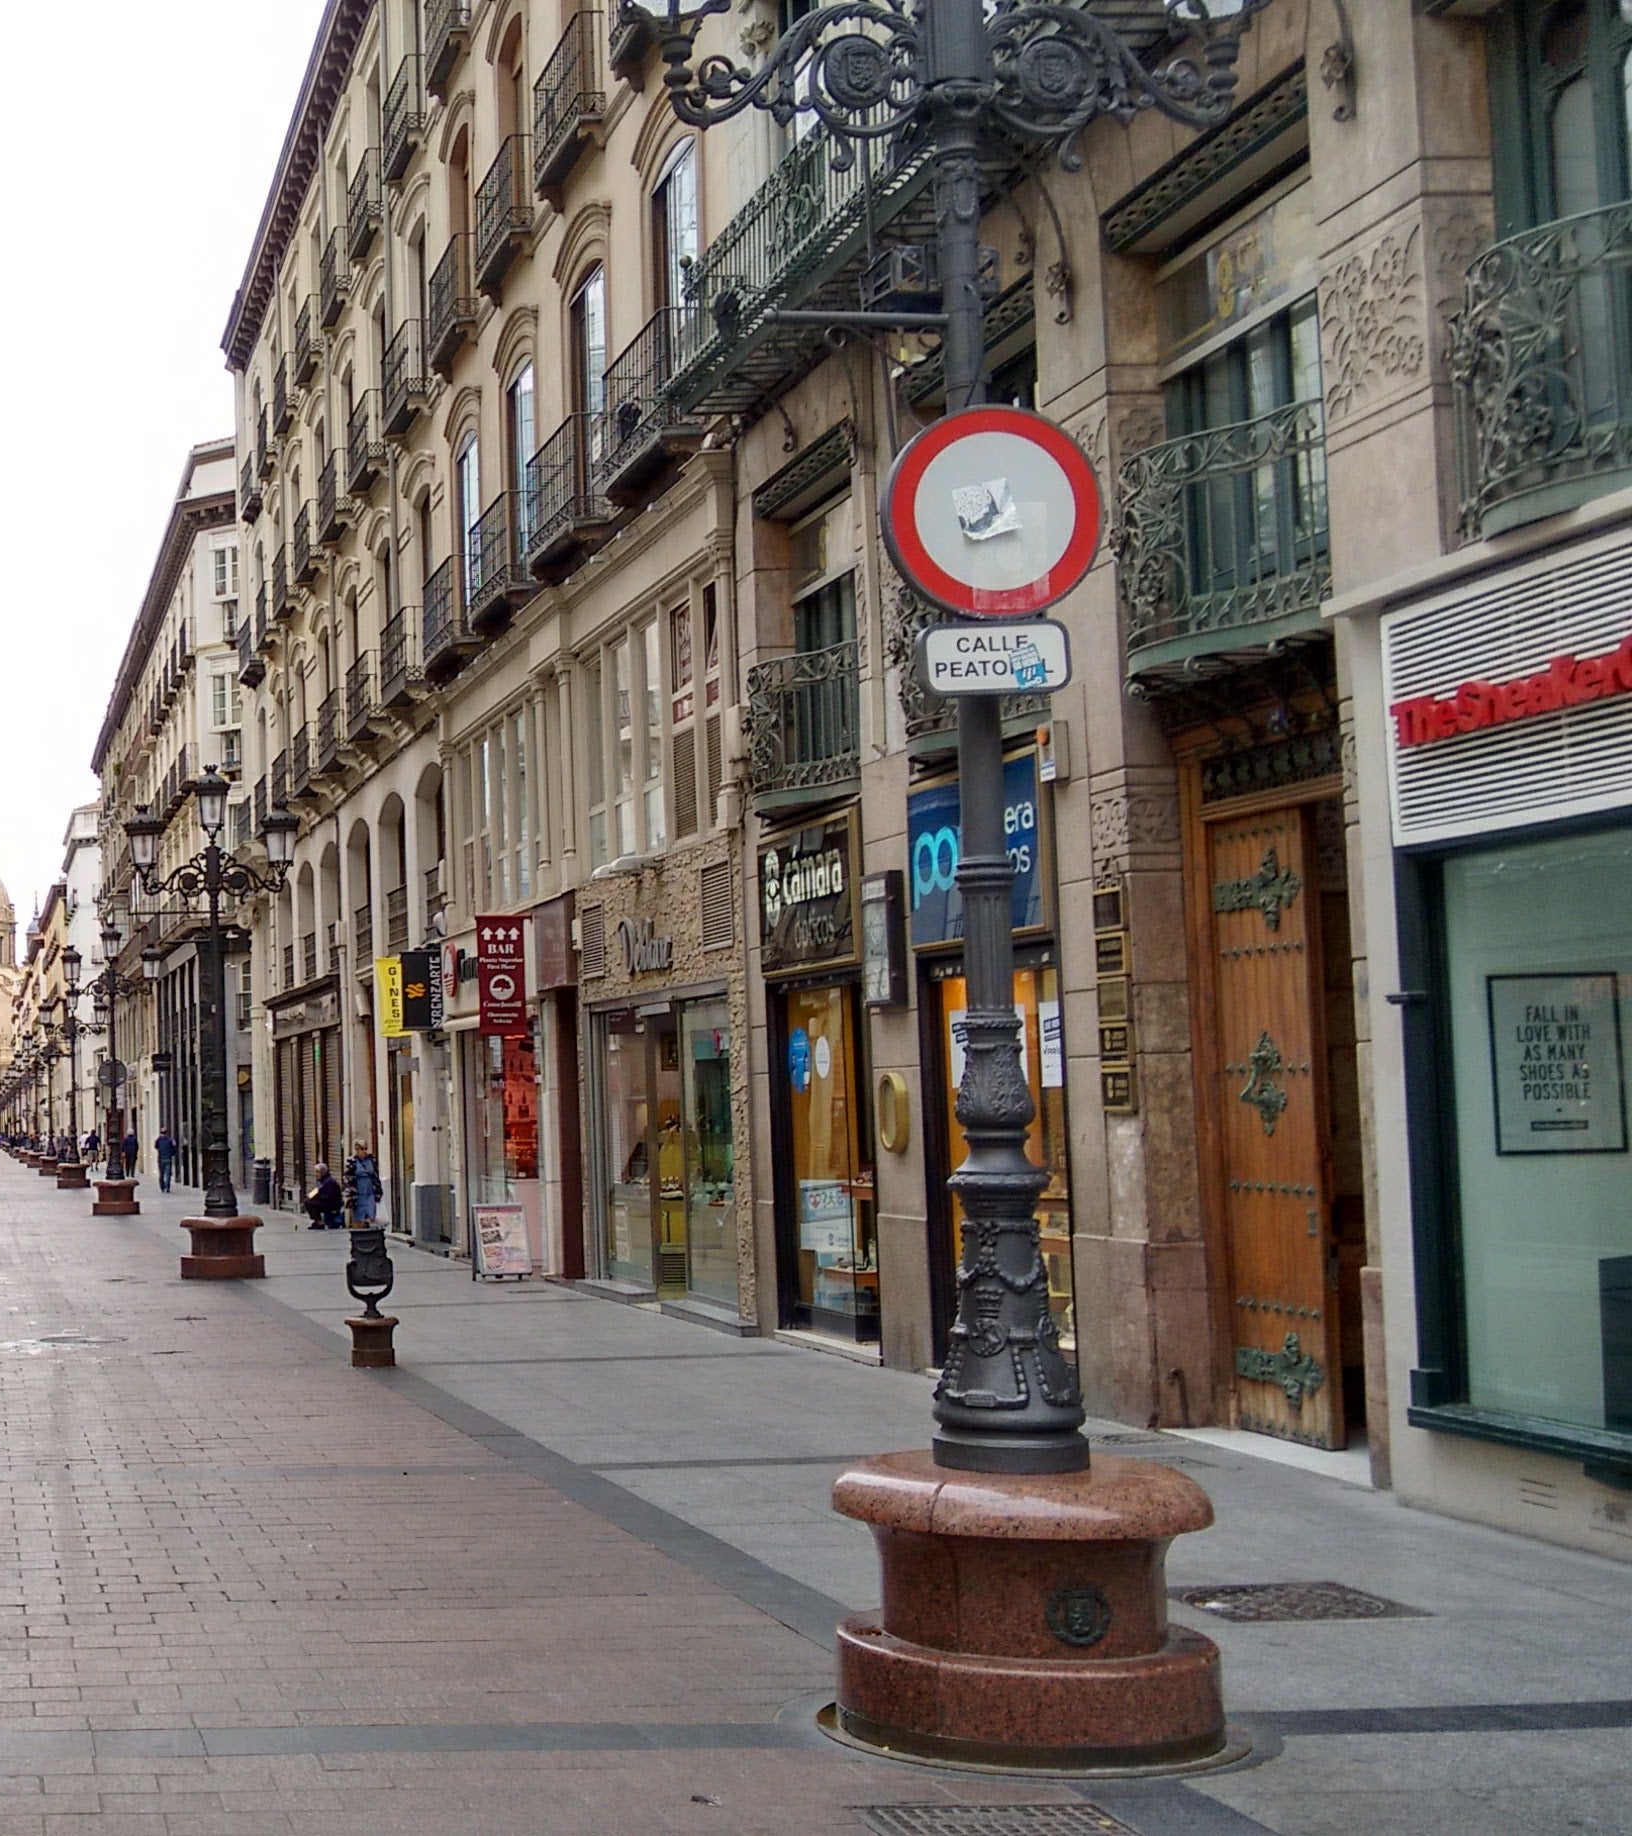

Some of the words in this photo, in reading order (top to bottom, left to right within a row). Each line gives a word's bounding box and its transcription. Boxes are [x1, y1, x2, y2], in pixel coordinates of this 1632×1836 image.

[956, 635, 1028, 653] CALLE
[935, 656, 1054, 679] PEATOL
[783, 844, 843, 905] cámara
[487, 944, 514, 954] BAR
[388, 967, 400, 1018] GINES
[1526, 1006, 1559, 1023] FALL
[1565, 1005, 1579, 1021] IN
[1516, 1025, 1551, 1043] LOVE
[1557, 1024, 1591, 1041] WITH
[1524, 1044, 1541, 1061] AS
[1547, 1044, 1585, 1061] MANY
[1520, 1064, 1564, 1081] SHOES
[1572, 1064, 1590, 1080] AS
[1523, 1082, 1591, 1100] POSSIBLE
